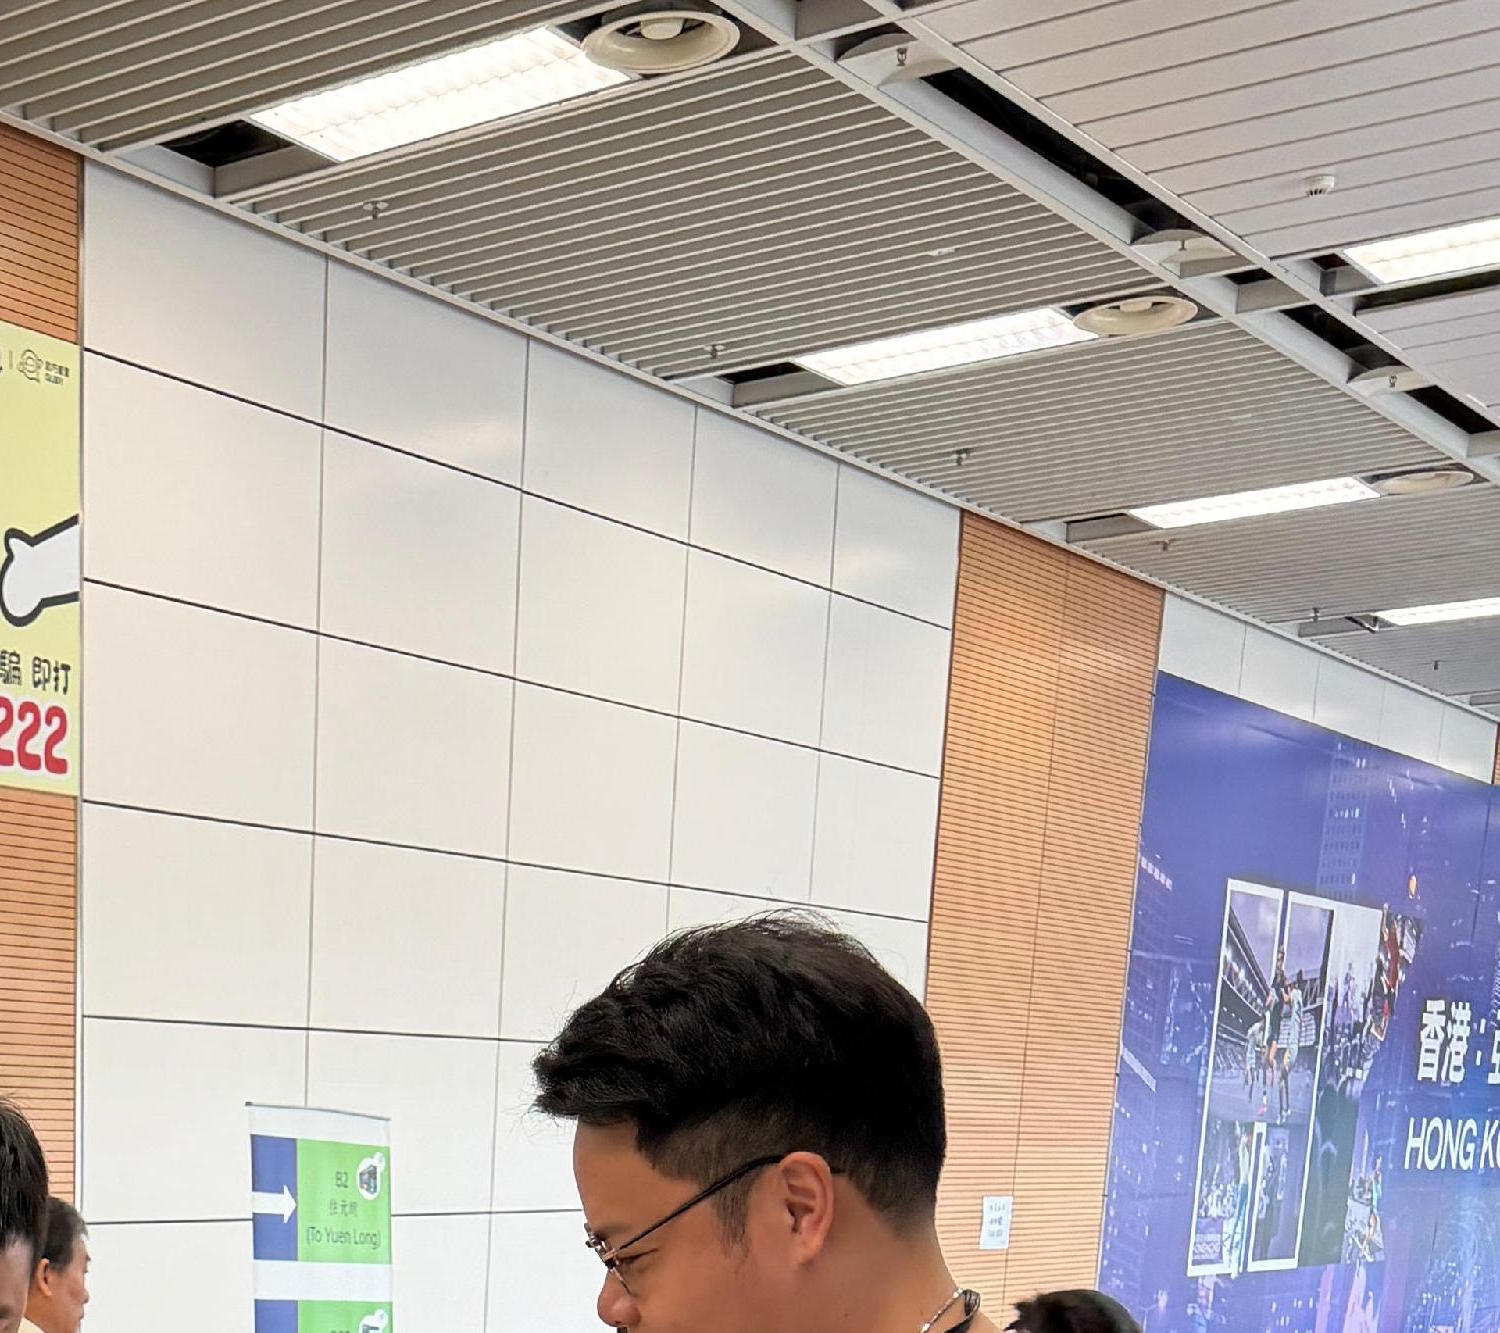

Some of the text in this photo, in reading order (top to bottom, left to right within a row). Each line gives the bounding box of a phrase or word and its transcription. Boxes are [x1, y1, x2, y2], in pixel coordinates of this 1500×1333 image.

[32, 656, 71, 695] 即打
[1404, 1116, 1500, 1170] HONG K
[326, 1227, 351, 1246] Yuen
